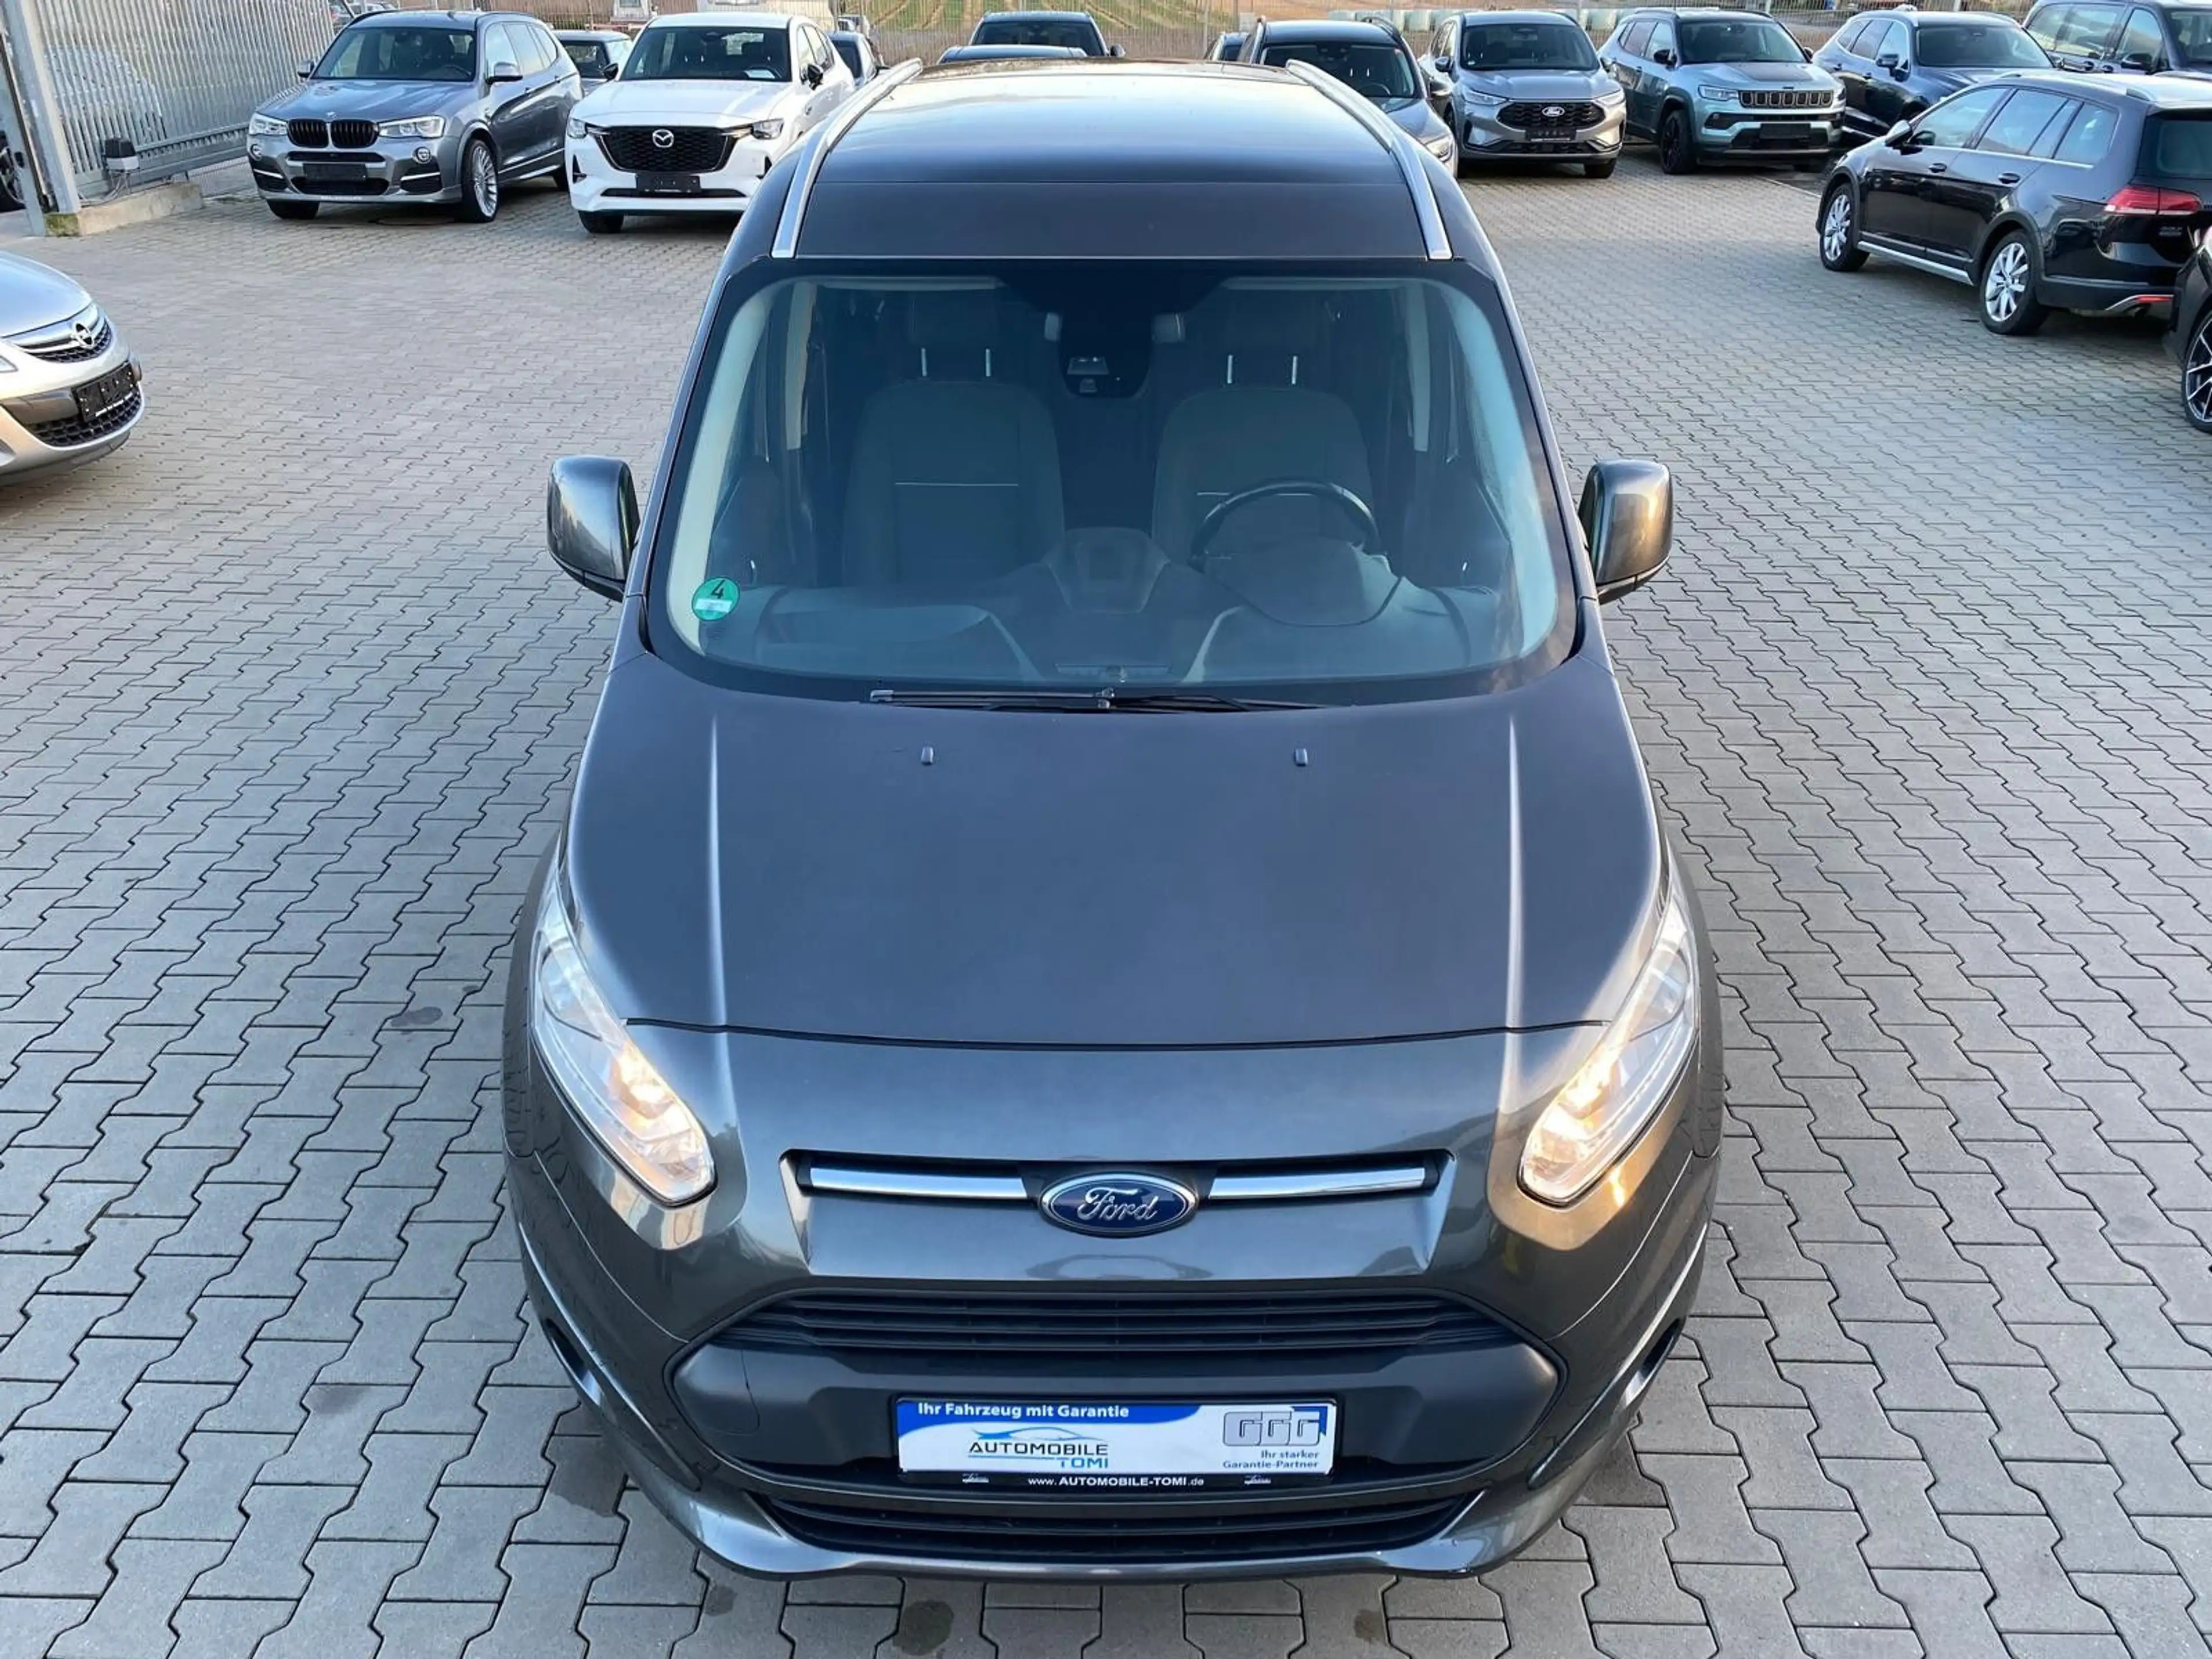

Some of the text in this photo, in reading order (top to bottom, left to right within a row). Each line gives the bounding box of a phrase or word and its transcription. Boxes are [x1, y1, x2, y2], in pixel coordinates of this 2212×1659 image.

[711, 579, 725, 599] 4
[1077, 1187, 1159, 1221] Ford
[918, 1403, 1129, 1419] Ihr Fahrzeug mit Garantie
[969, 1442, 1108, 1456] AUTOMOBILE
[1261, 1450, 1319, 1459] Ihr starker
[1056, 1457, 1108, 1469] TOMI
[1223, 1460, 1319, 1469] Garantie-Partner
